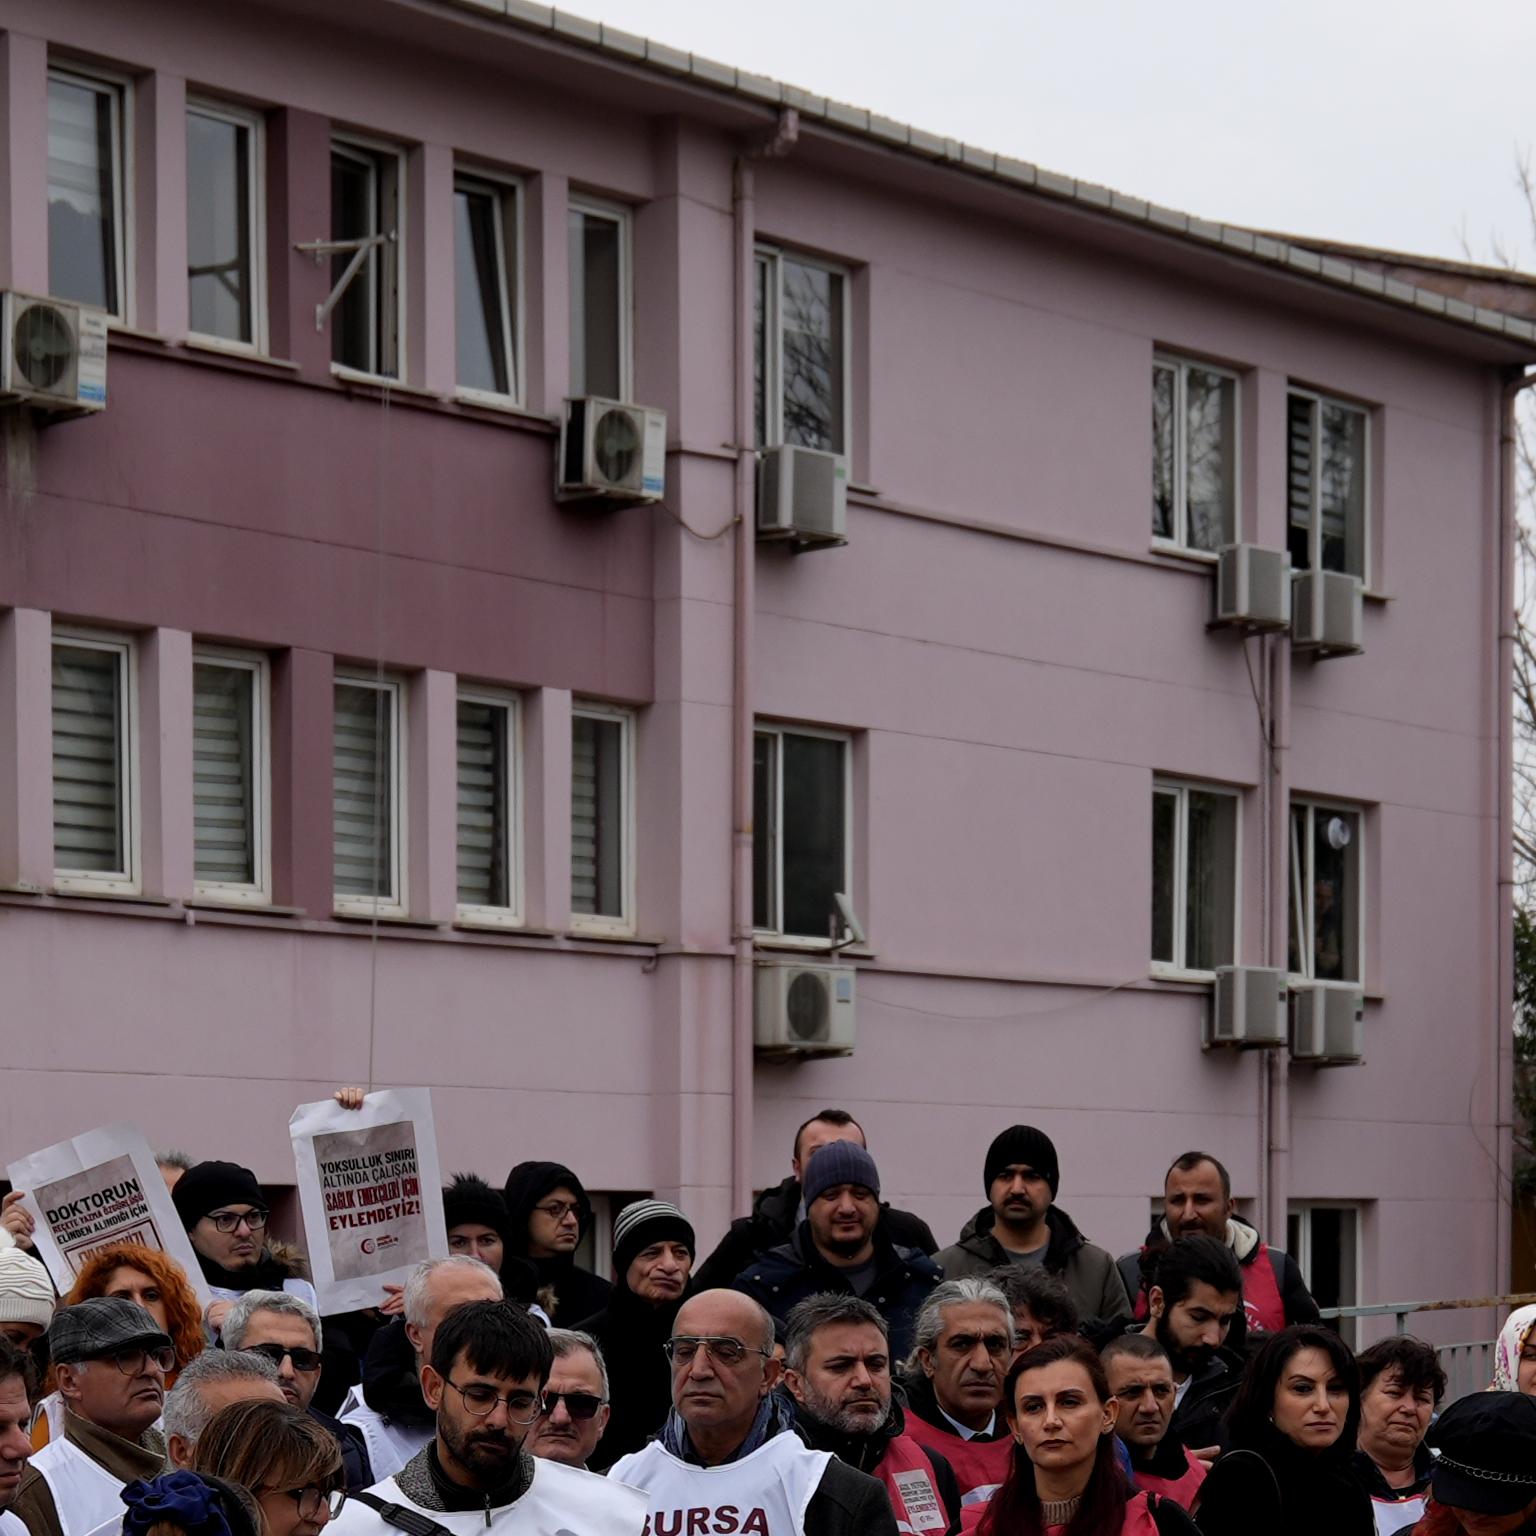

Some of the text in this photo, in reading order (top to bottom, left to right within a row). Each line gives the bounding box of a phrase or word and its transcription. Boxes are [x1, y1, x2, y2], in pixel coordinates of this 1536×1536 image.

[321, 1148, 415, 1175] YOKSULLUK SINIRI
[323, 1162, 417, 1189] ALTINDA ÇALIŞAN
[46, 1178, 140, 1225] DOKTORUN
[329, 1198, 421, 1231] EYLEMDEYİZ!
